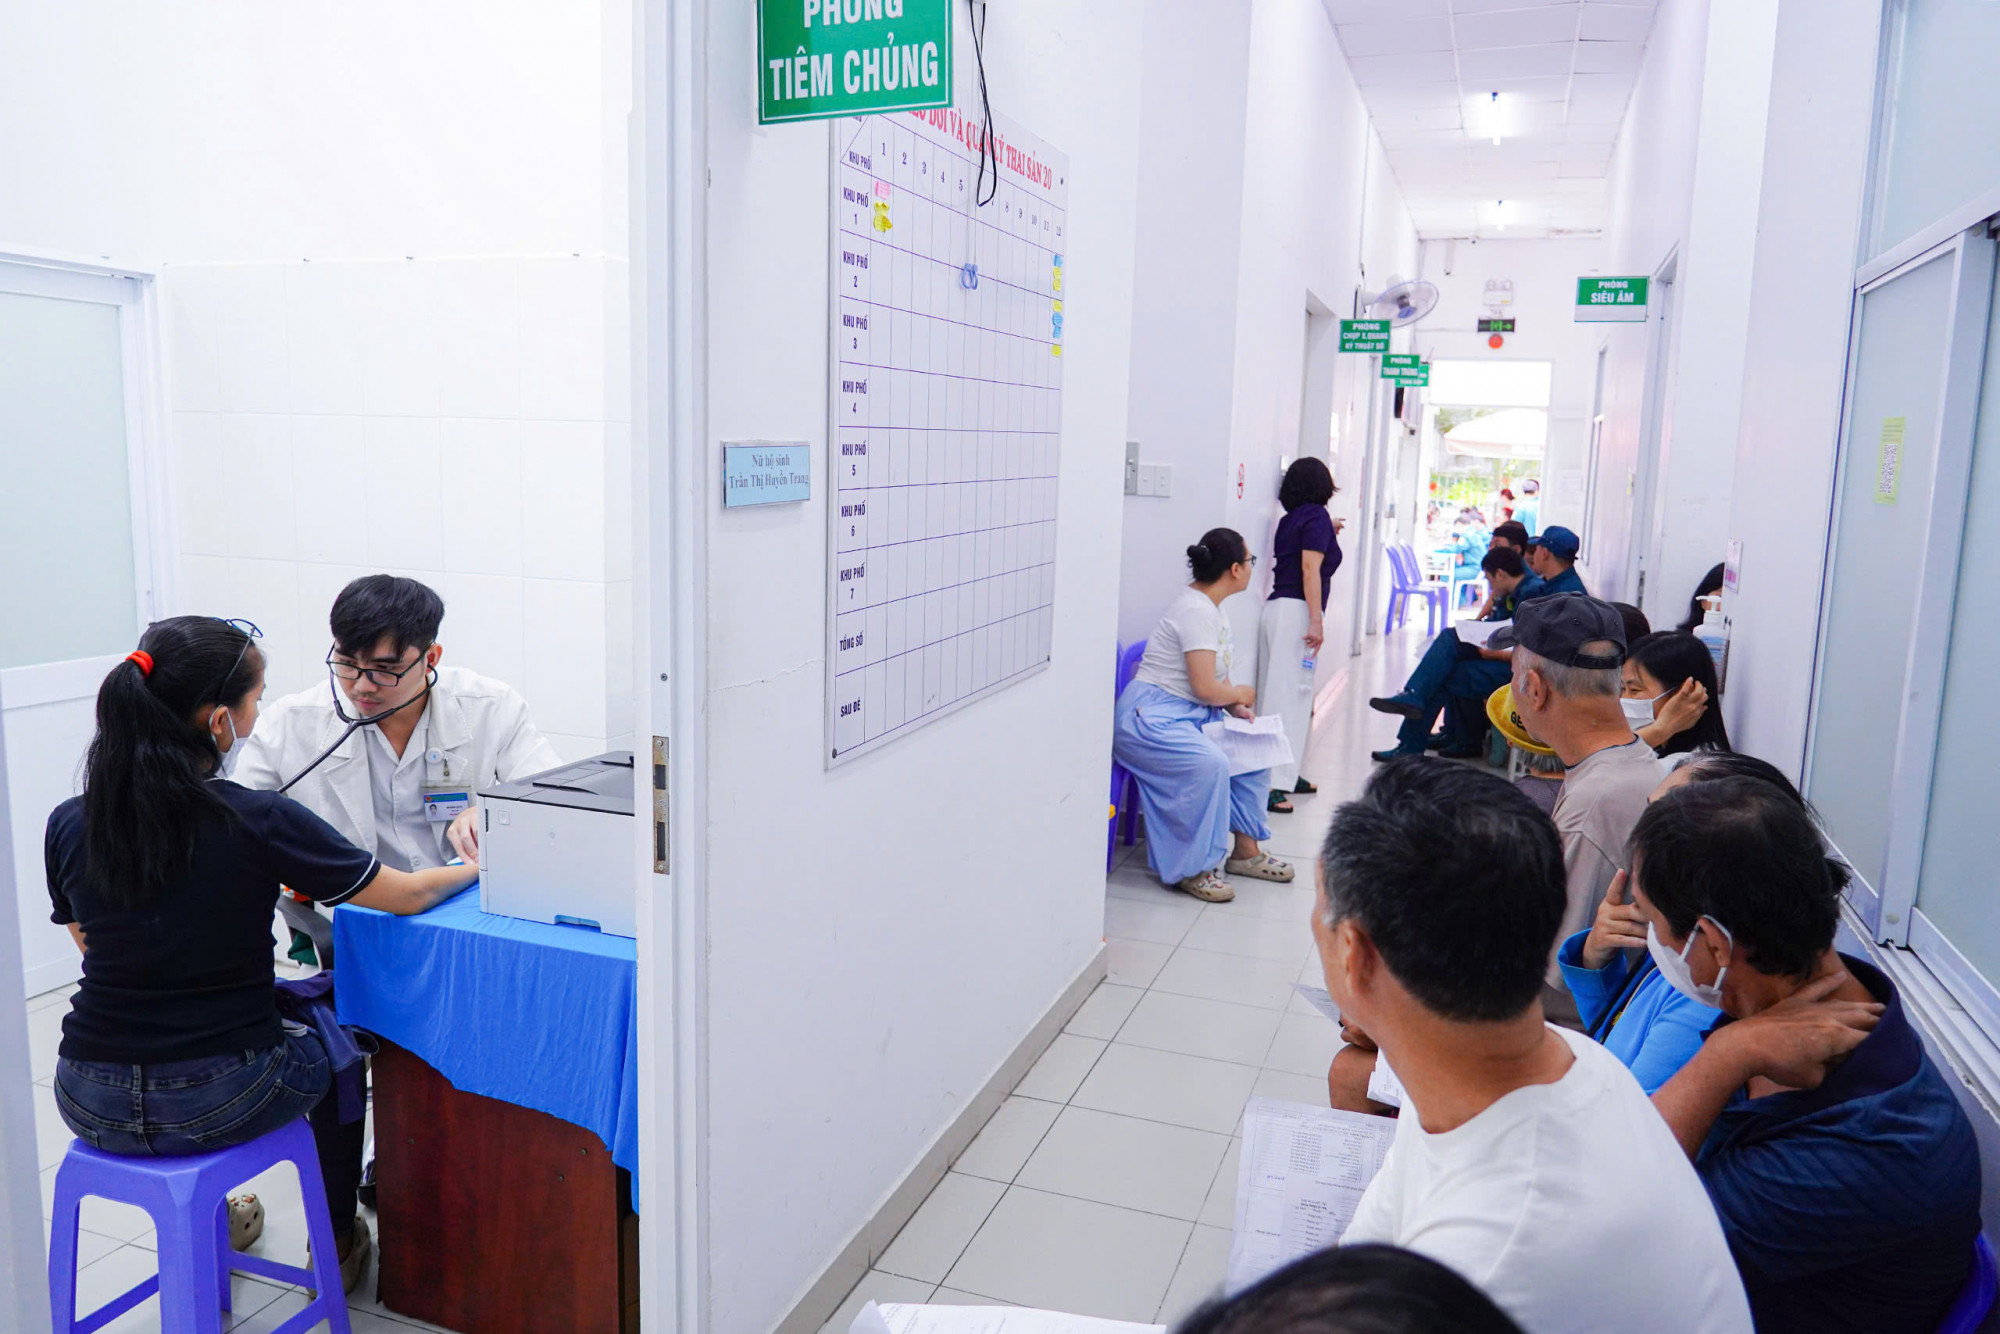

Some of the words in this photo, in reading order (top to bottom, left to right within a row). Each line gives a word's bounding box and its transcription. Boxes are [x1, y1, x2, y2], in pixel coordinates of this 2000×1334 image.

[769, 46, 833, 100] TIÊM
[843, 32, 939, 95] CHỦNG
[950, 107, 964, 142] VÀ
[1006, 144, 1025, 176] THAI
[1043, 165, 1052, 190] 20
[849, 150, 860, 165] KHU
[881, 142, 886, 156] 1
[902, 152, 907, 165] 2
[922, 161, 927, 175] 3
[940, 171, 945, 183] 4
[958, 179, 963, 191] 5
[1005, 201, 1010, 213] 8
[1018, 208, 1023, 219] 9
[843, 187, 856, 203] KHU
[856, 192, 869, 208] PHỐ
[854, 213, 858, 225] 1
[843, 250, 855, 265] KHU
[856, 253, 868, 269] PHỐ
[853, 275, 858, 288] 2
[1591, 290, 1614, 303] SIÊU
[1616, 290, 1634, 303] ÂM
[843, 314, 855, 328] KHU
[856, 315, 868, 330] PHỐ
[853, 337, 858, 349] 3
[842, 380, 854, 393] KHU
[855, 378, 867, 394] PHỐ
[852, 402, 857, 413] 4
[842, 443, 854, 455] KHU
[854, 440, 866, 455] PHỐ
[776, 453, 790, 466] sinh
[852, 464, 856, 476] 5
[750, 474, 763, 490] Thị
[789, 472, 809, 487] Trang
[841, 505, 853, 517] KHU
[854, 500, 866, 516] PHỐ
[851, 525, 855, 536] 6
[840, 568, 852, 581] KHU
[853, 562, 865, 579] PHỐ
[850, 588, 854, 599] 7
[839, 633, 854, 651] TỔNG
[855, 630, 864, 646] SỐ
[840, 701, 852, 717] SAU
